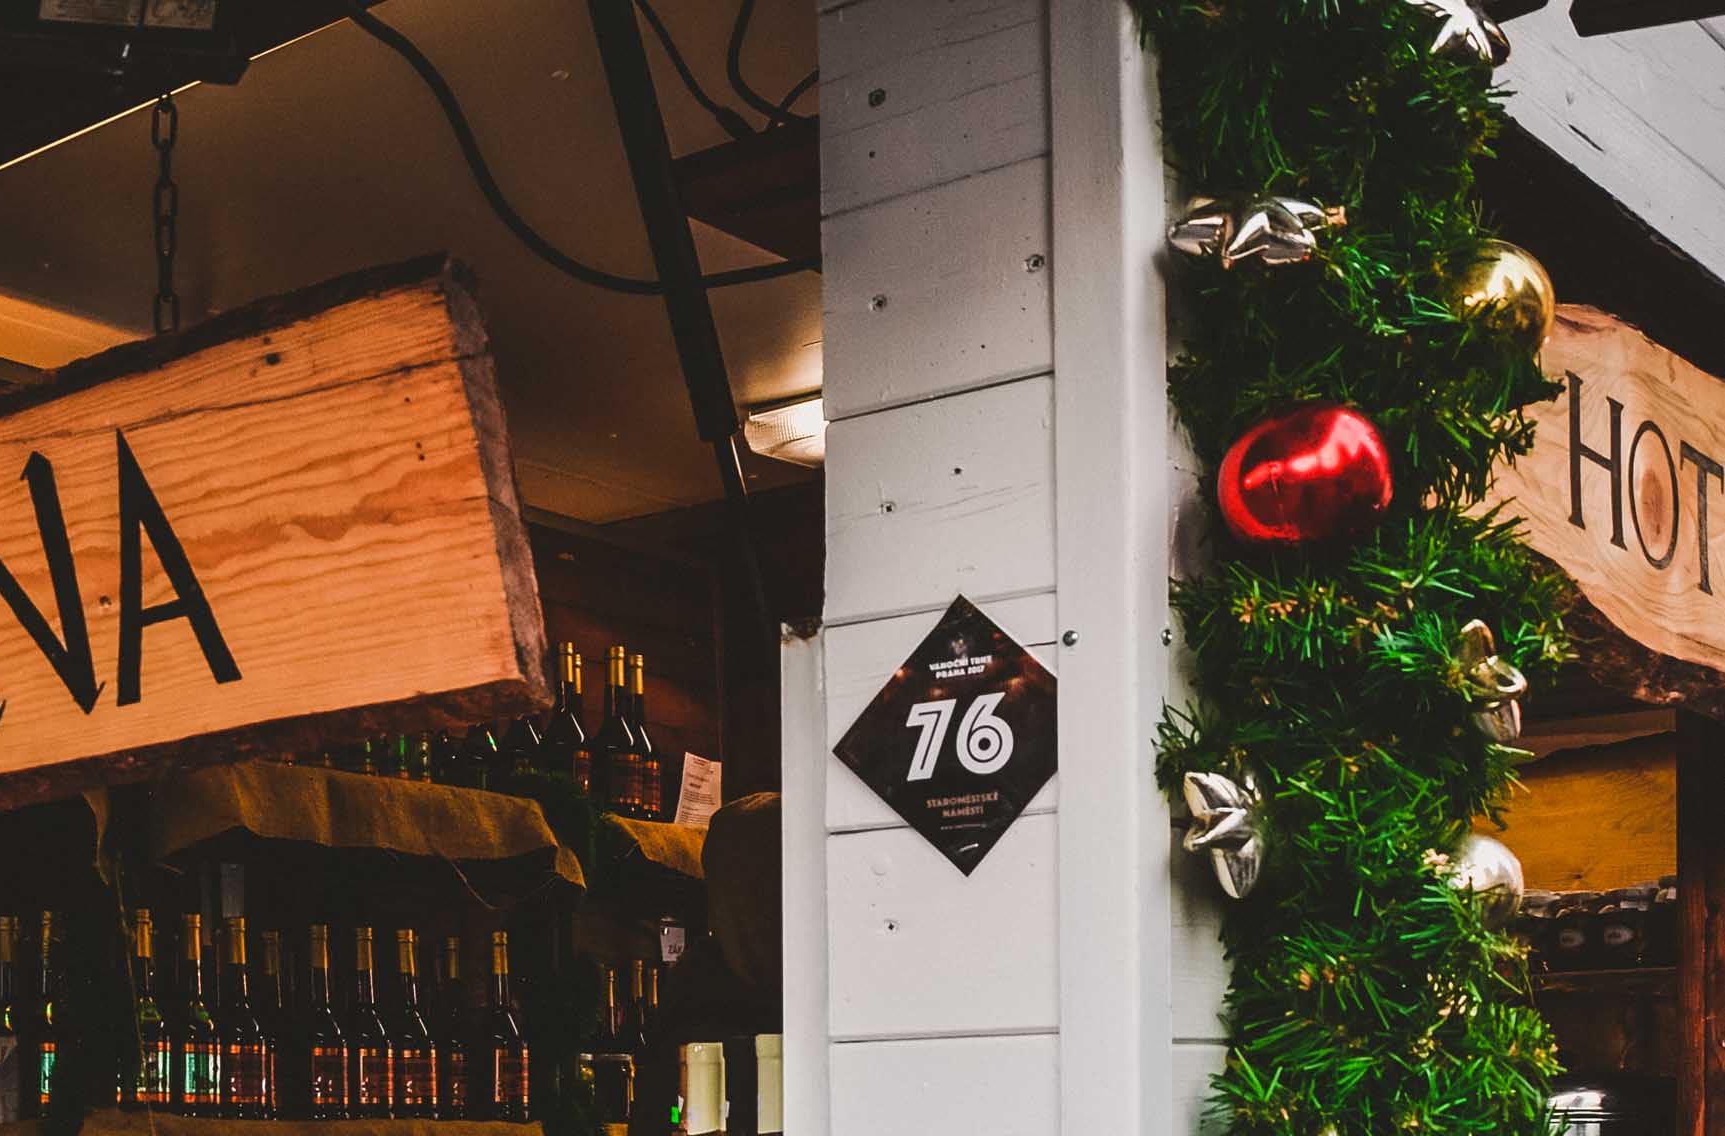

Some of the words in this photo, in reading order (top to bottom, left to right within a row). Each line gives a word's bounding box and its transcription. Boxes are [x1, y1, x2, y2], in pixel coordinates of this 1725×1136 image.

[1565, 370, 1725, 597] HOT
[935, 667, 966, 679] PRAHA
[906, 691, 1014, 782] 76
